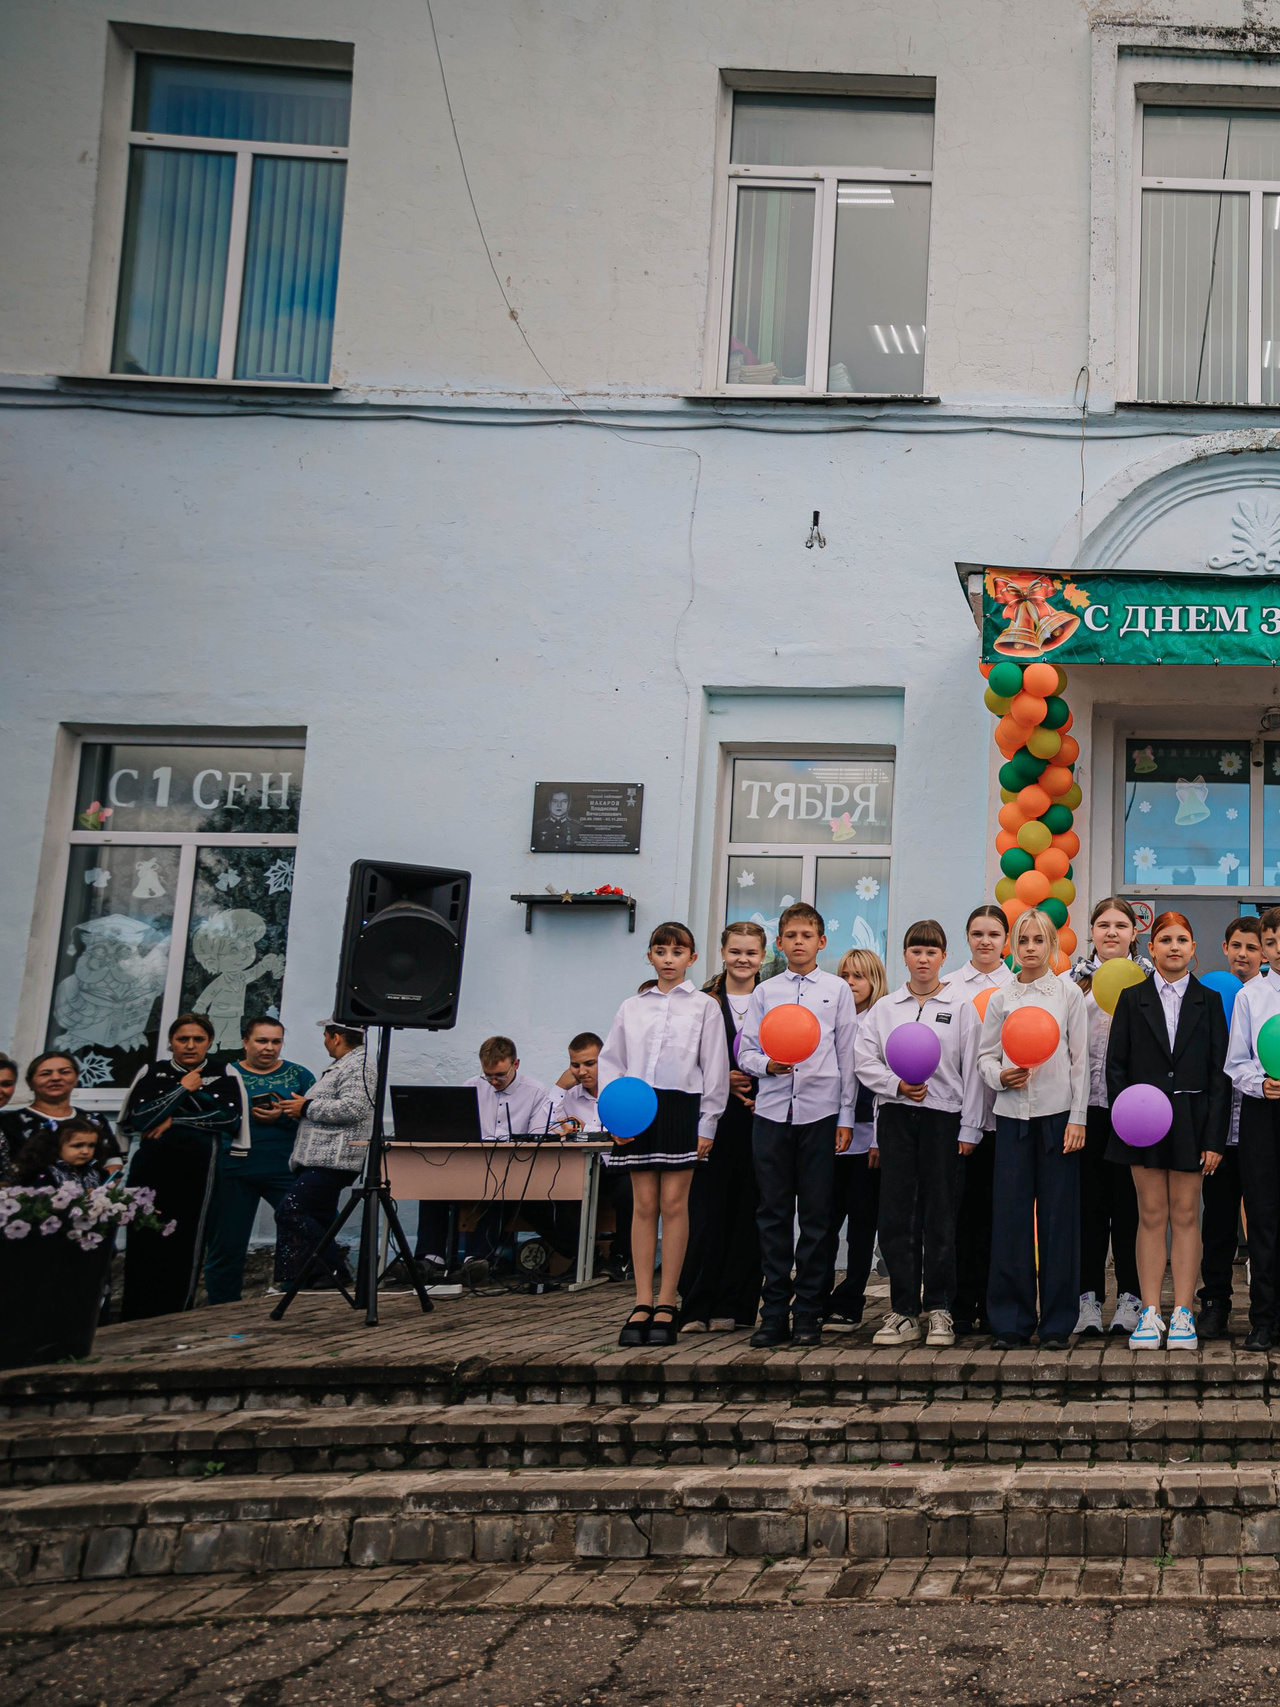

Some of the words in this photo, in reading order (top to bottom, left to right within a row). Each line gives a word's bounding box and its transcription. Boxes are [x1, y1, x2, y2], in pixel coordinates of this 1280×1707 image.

[1083, 604, 1110, 633] С
[1118, 604, 1250, 637] ДНЕМ
[109, 768, 139, 808] С
[152, 766, 173, 807] 1
[741, 780, 879, 823] ТЯБРЯ
